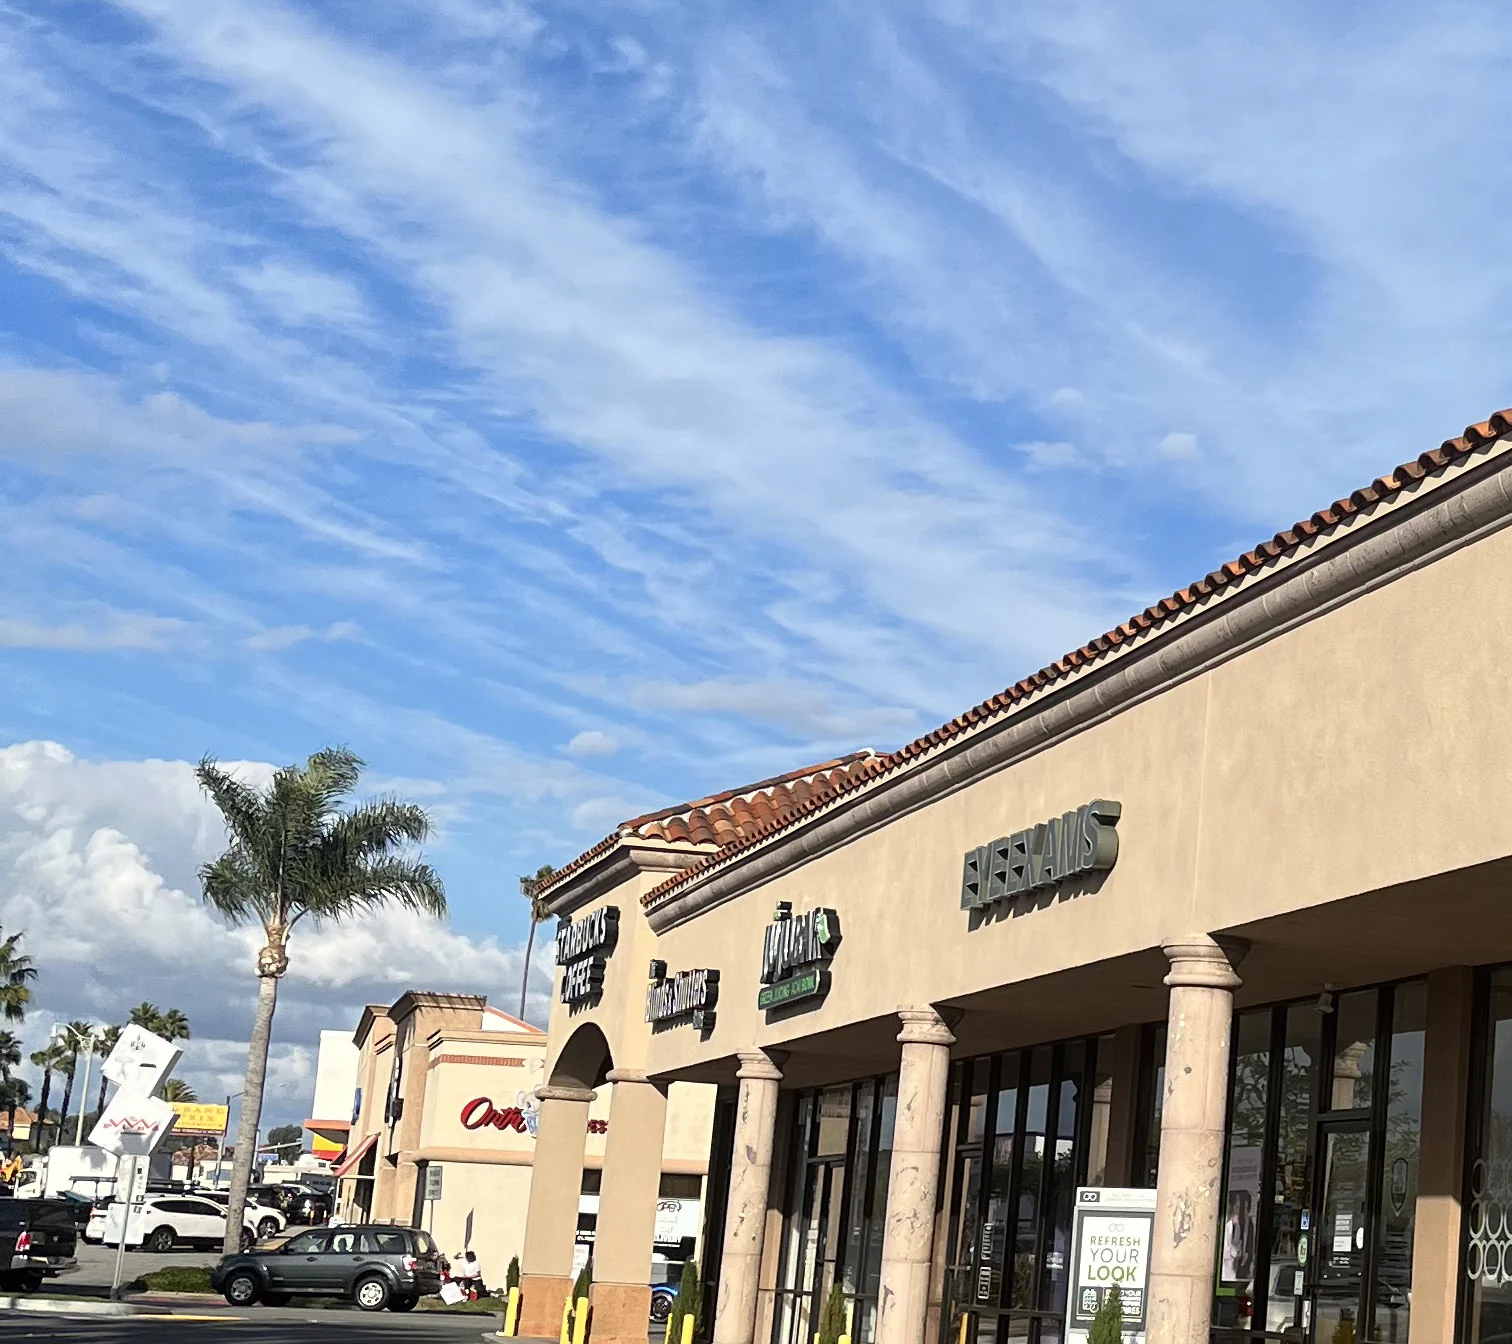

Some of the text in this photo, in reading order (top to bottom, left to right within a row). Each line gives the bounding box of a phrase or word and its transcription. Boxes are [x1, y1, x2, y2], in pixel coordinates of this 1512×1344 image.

[555, 905, 611, 964] STARBUCKS
[561, 956, 595, 1004] COFFEE
[1090, 1235, 1141, 1247] REFRESH
[1090, 1247, 1139, 1264] YOUR
[1087, 1264, 1137, 1282] LOOK
